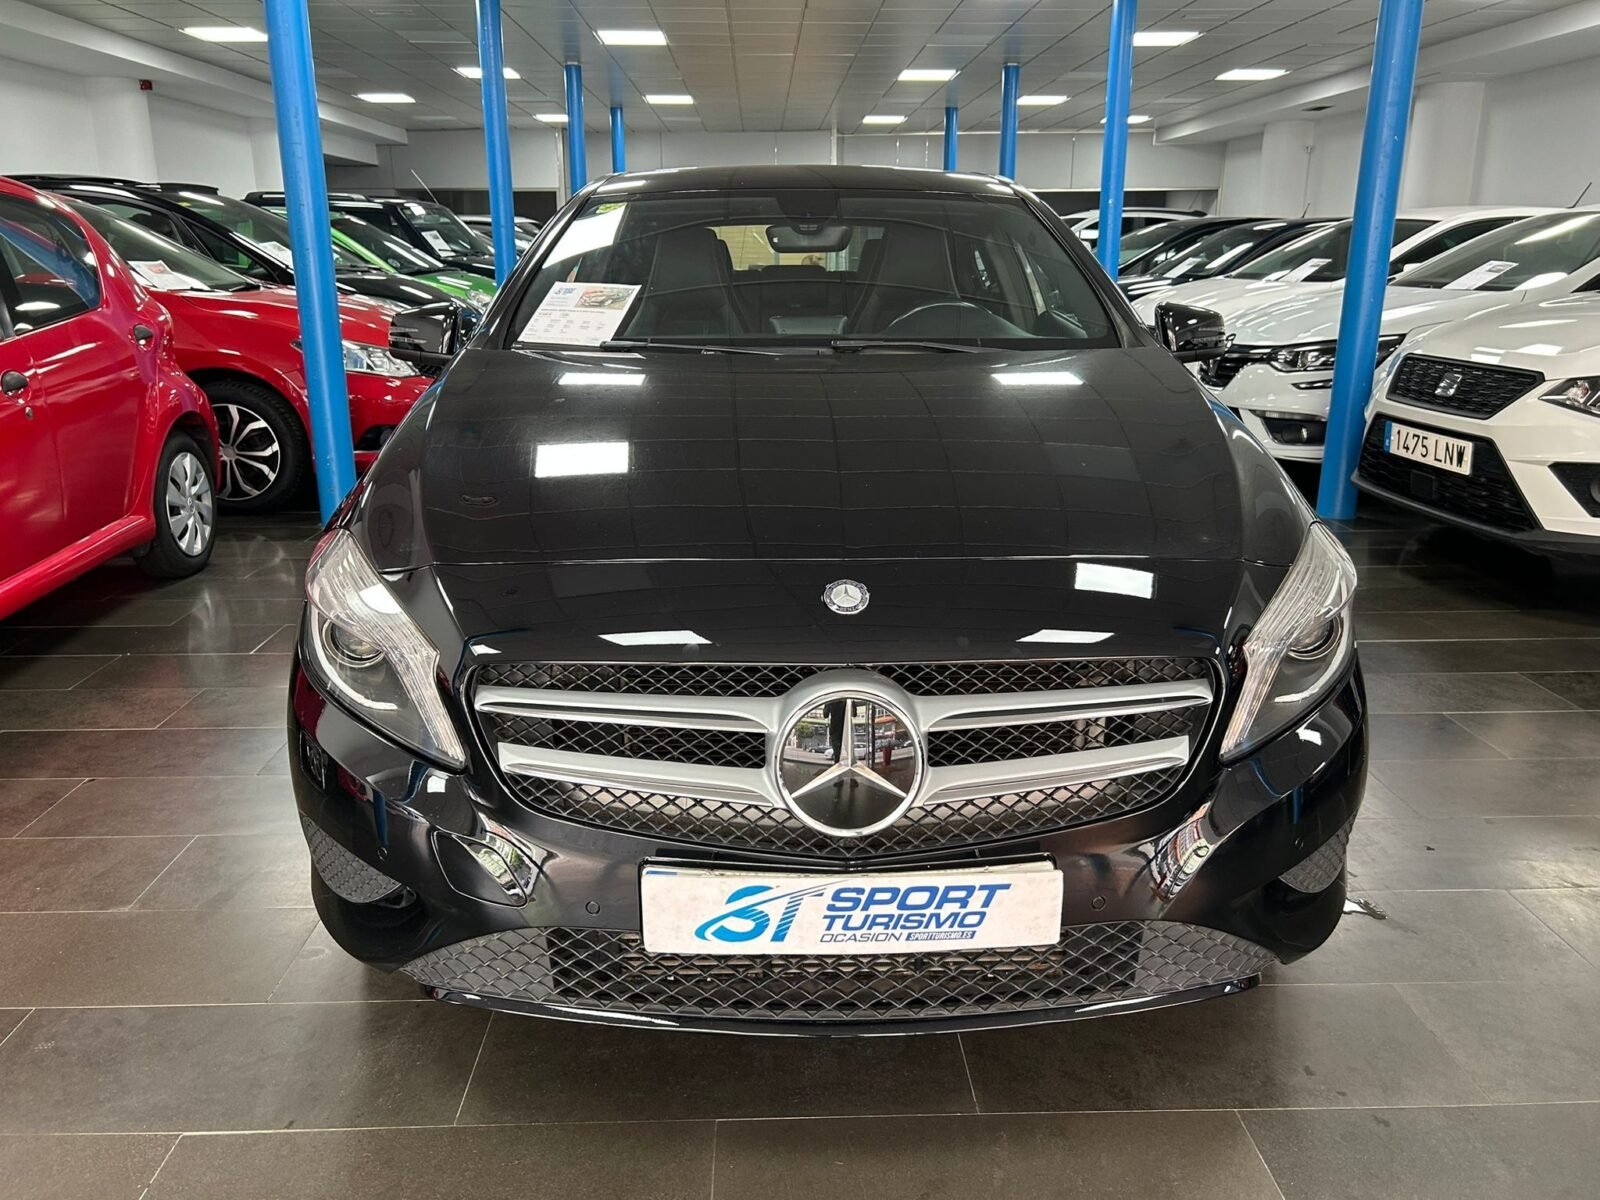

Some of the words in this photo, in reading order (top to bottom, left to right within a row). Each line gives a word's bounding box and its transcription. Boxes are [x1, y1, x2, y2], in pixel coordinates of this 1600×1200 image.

[1396, 428, 1428, 458] 1475
[1433, 439, 1466, 469] LNW
[825, 883, 1012, 912] SPORT
[822, 911, 987, 931] TURISMO
[819, 932, 903, 943] OCASION
